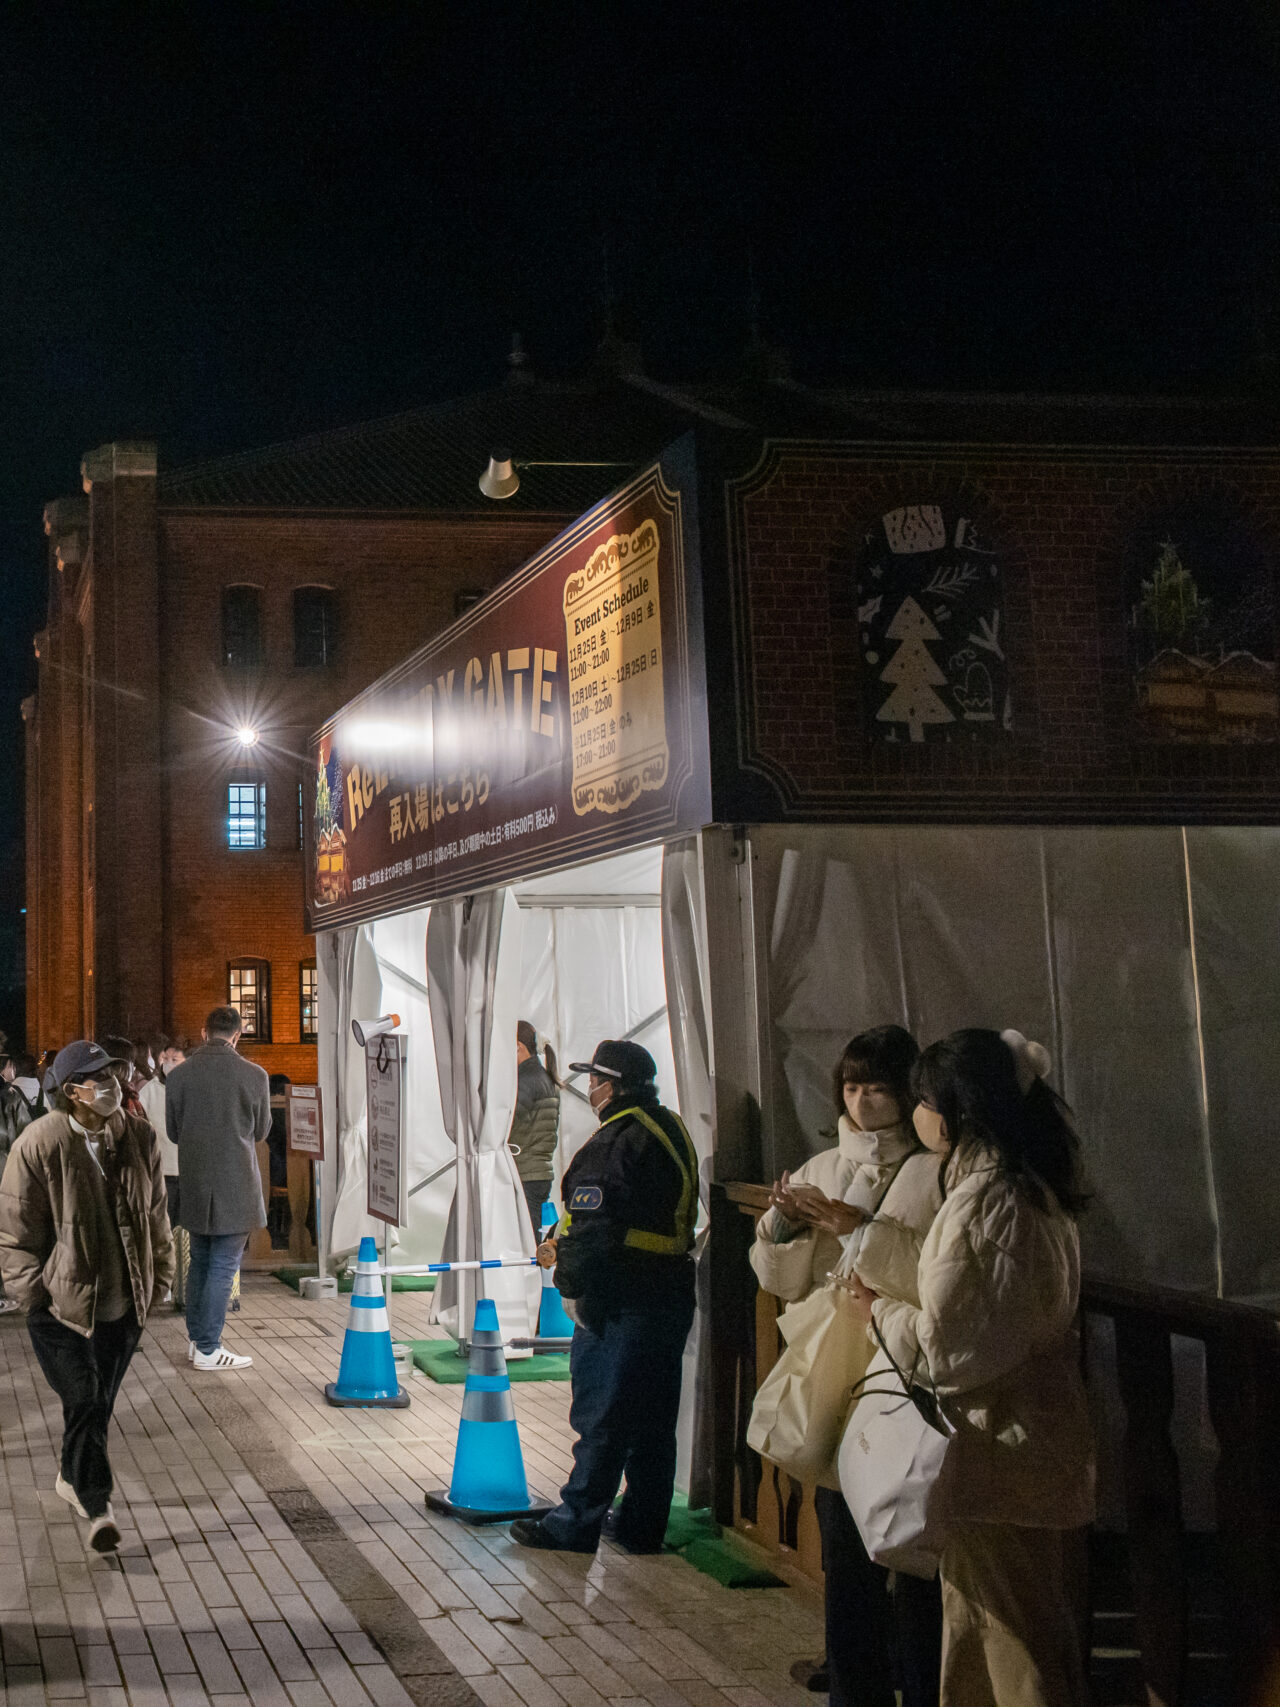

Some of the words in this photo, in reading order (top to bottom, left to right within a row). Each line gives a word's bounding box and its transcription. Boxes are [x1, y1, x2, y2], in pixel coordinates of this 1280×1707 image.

[574, 606, 601, 636] Event
[603, 577, 649, 618] Schedule
[389, 768, 490, 845] 再入場はこちら
